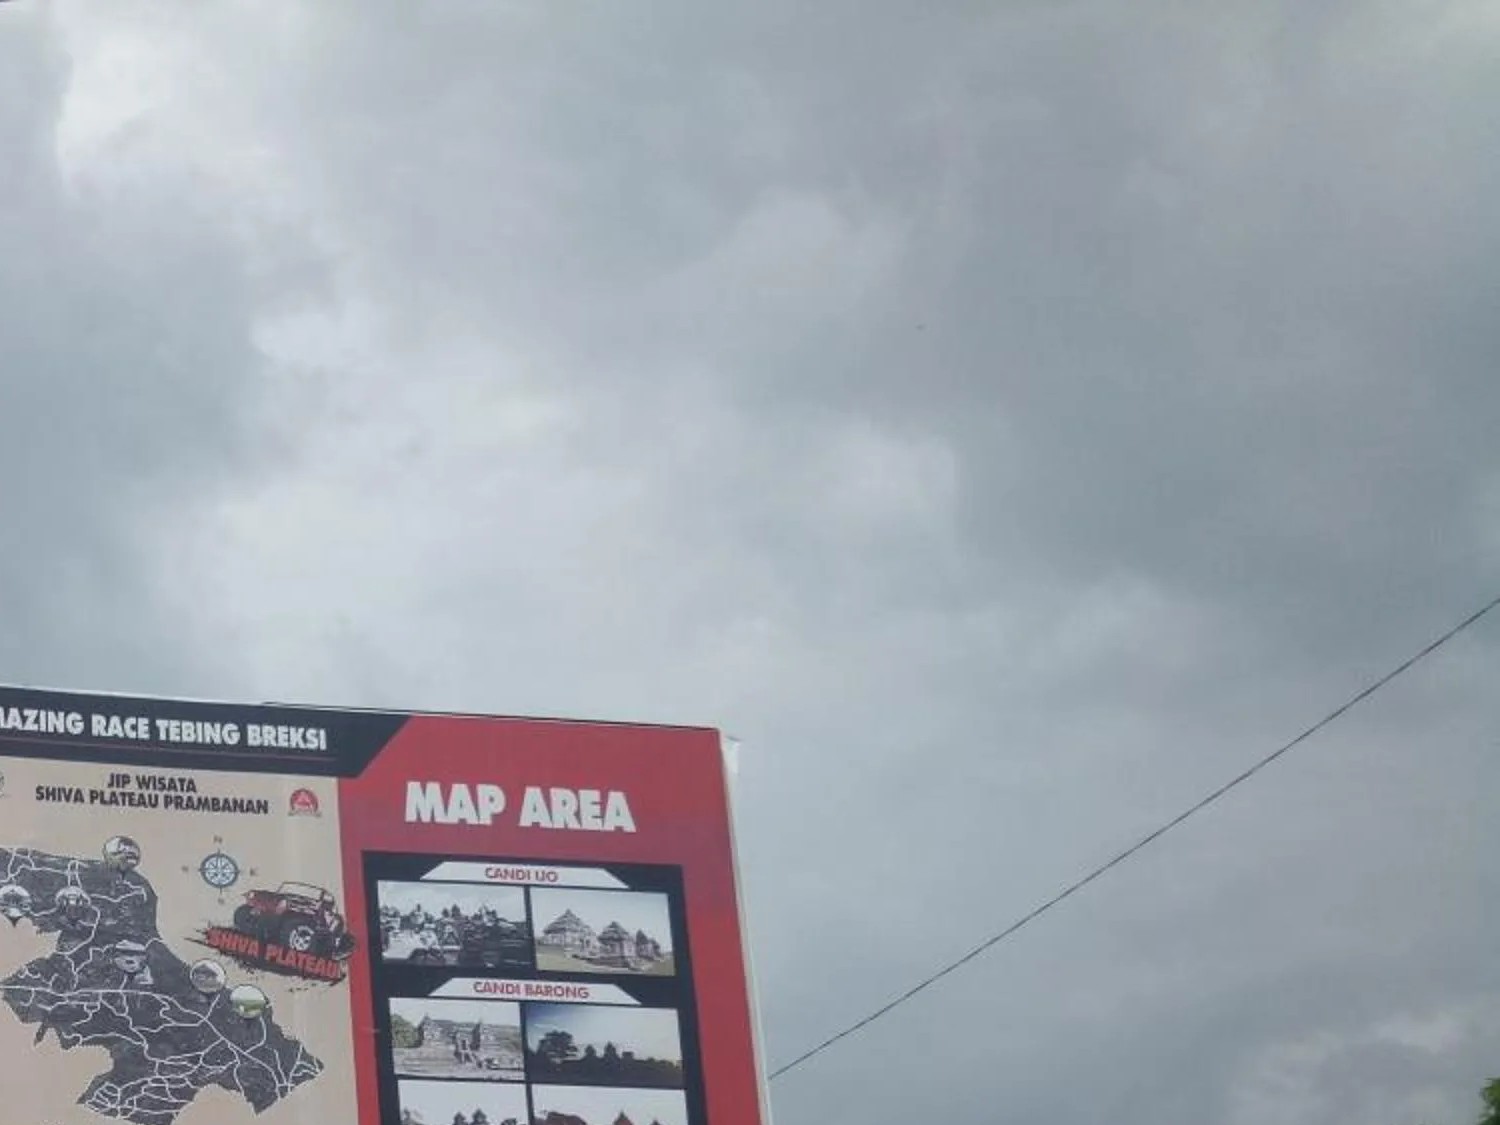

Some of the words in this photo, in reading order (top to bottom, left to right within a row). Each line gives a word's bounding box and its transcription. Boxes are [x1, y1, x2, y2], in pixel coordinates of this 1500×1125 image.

[91, 715, 150, 740] RACE
[155, 719, 240, 745] TEBING
[248, 724, 327, 750] BREKSI
[106, 772, 132, 789] JIP
[136, 775, 198, 794] WISATA
[35, 786, 86, 804] SHIVA
[89, 789, 160, 809] PLATEAU
[163, 794, 269, 815] PRAMBANAN
[404, 781, 507, 826] MAP
[519, 785, 637, 833] AREA
[484, 867, 531, 881] CANDI
[205, 928, 260, 957] SHIVA
[264, 945, 342, 979] PLATEAU
[473, 981, 521, 995] CANDI
[524, 983, 590, 999] BARONG
